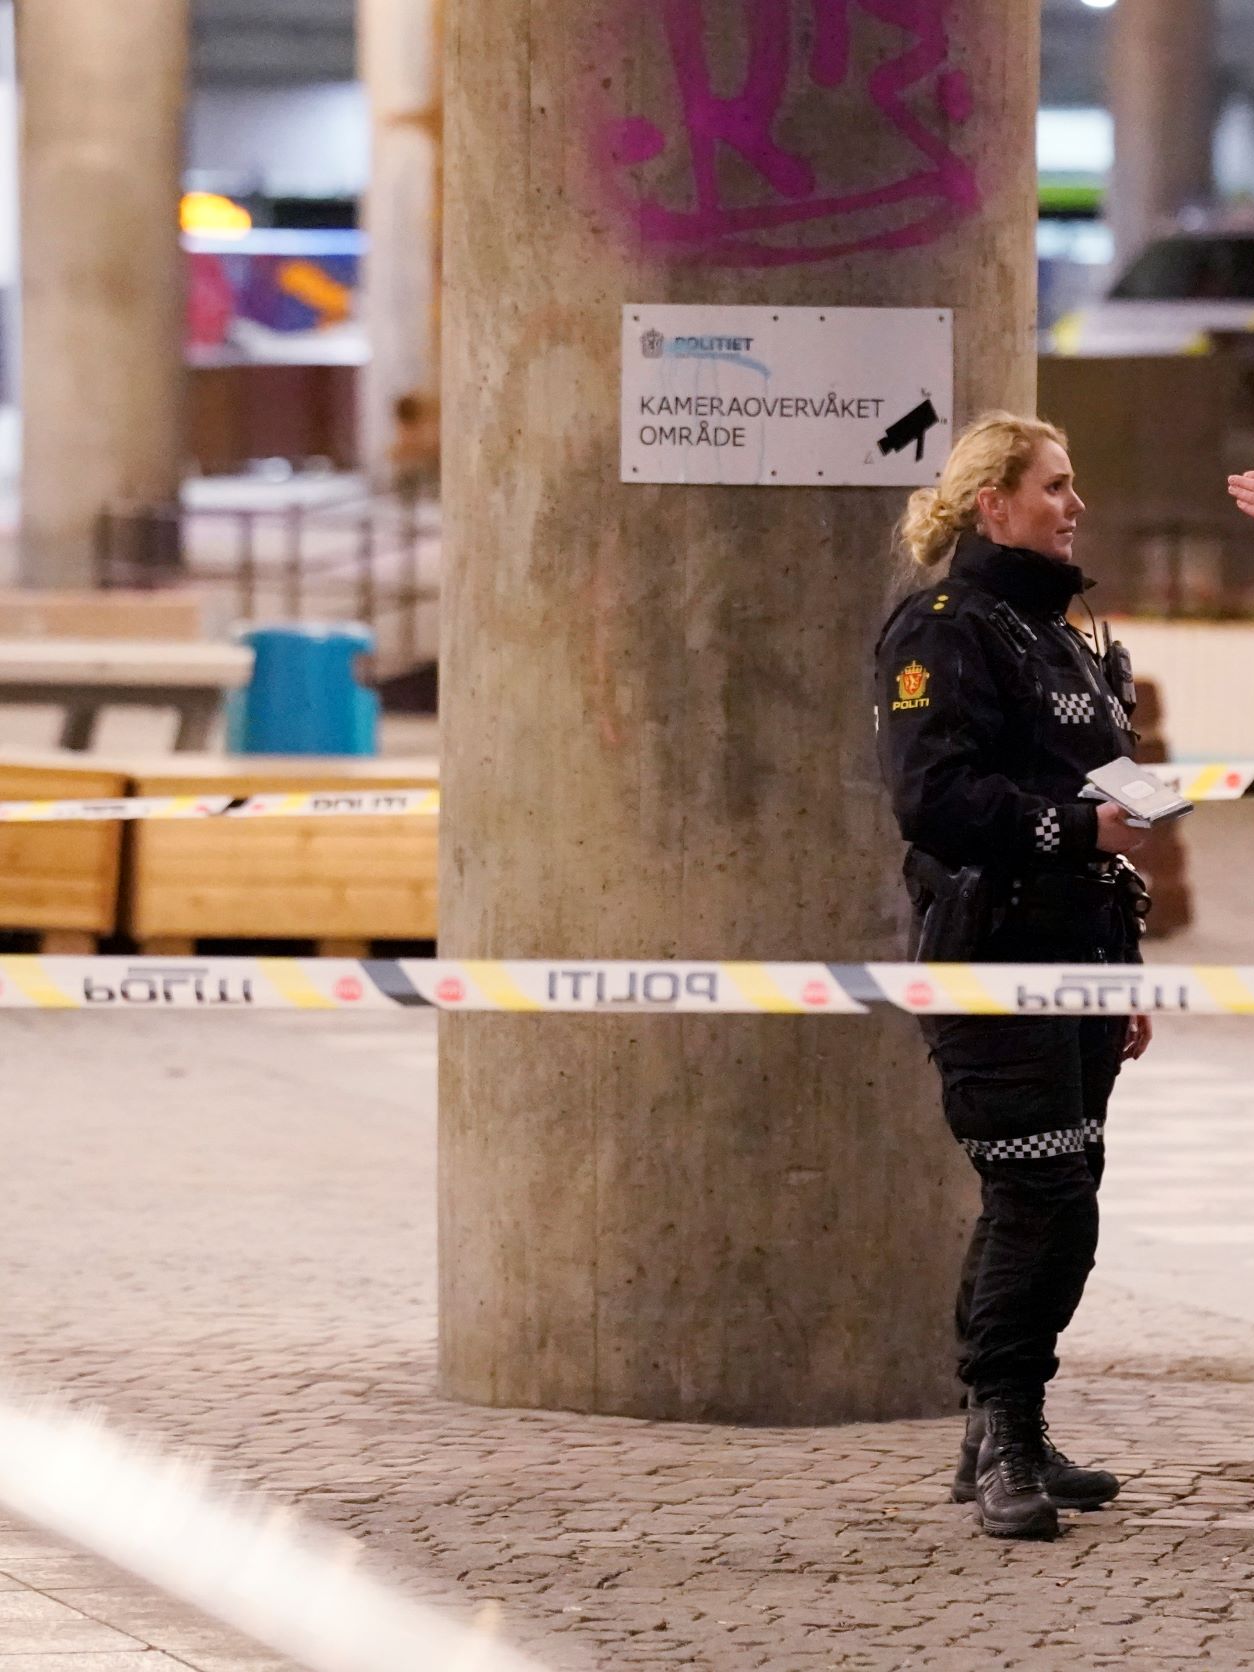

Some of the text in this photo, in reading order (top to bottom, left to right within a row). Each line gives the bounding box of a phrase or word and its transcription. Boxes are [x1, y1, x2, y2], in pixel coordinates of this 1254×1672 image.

[640, 392, 885, 419] KAMERAOVERVÅKET
[639, 420, 746, 447] OMRÅDE
[892, 697, 930, 711] POLITI
